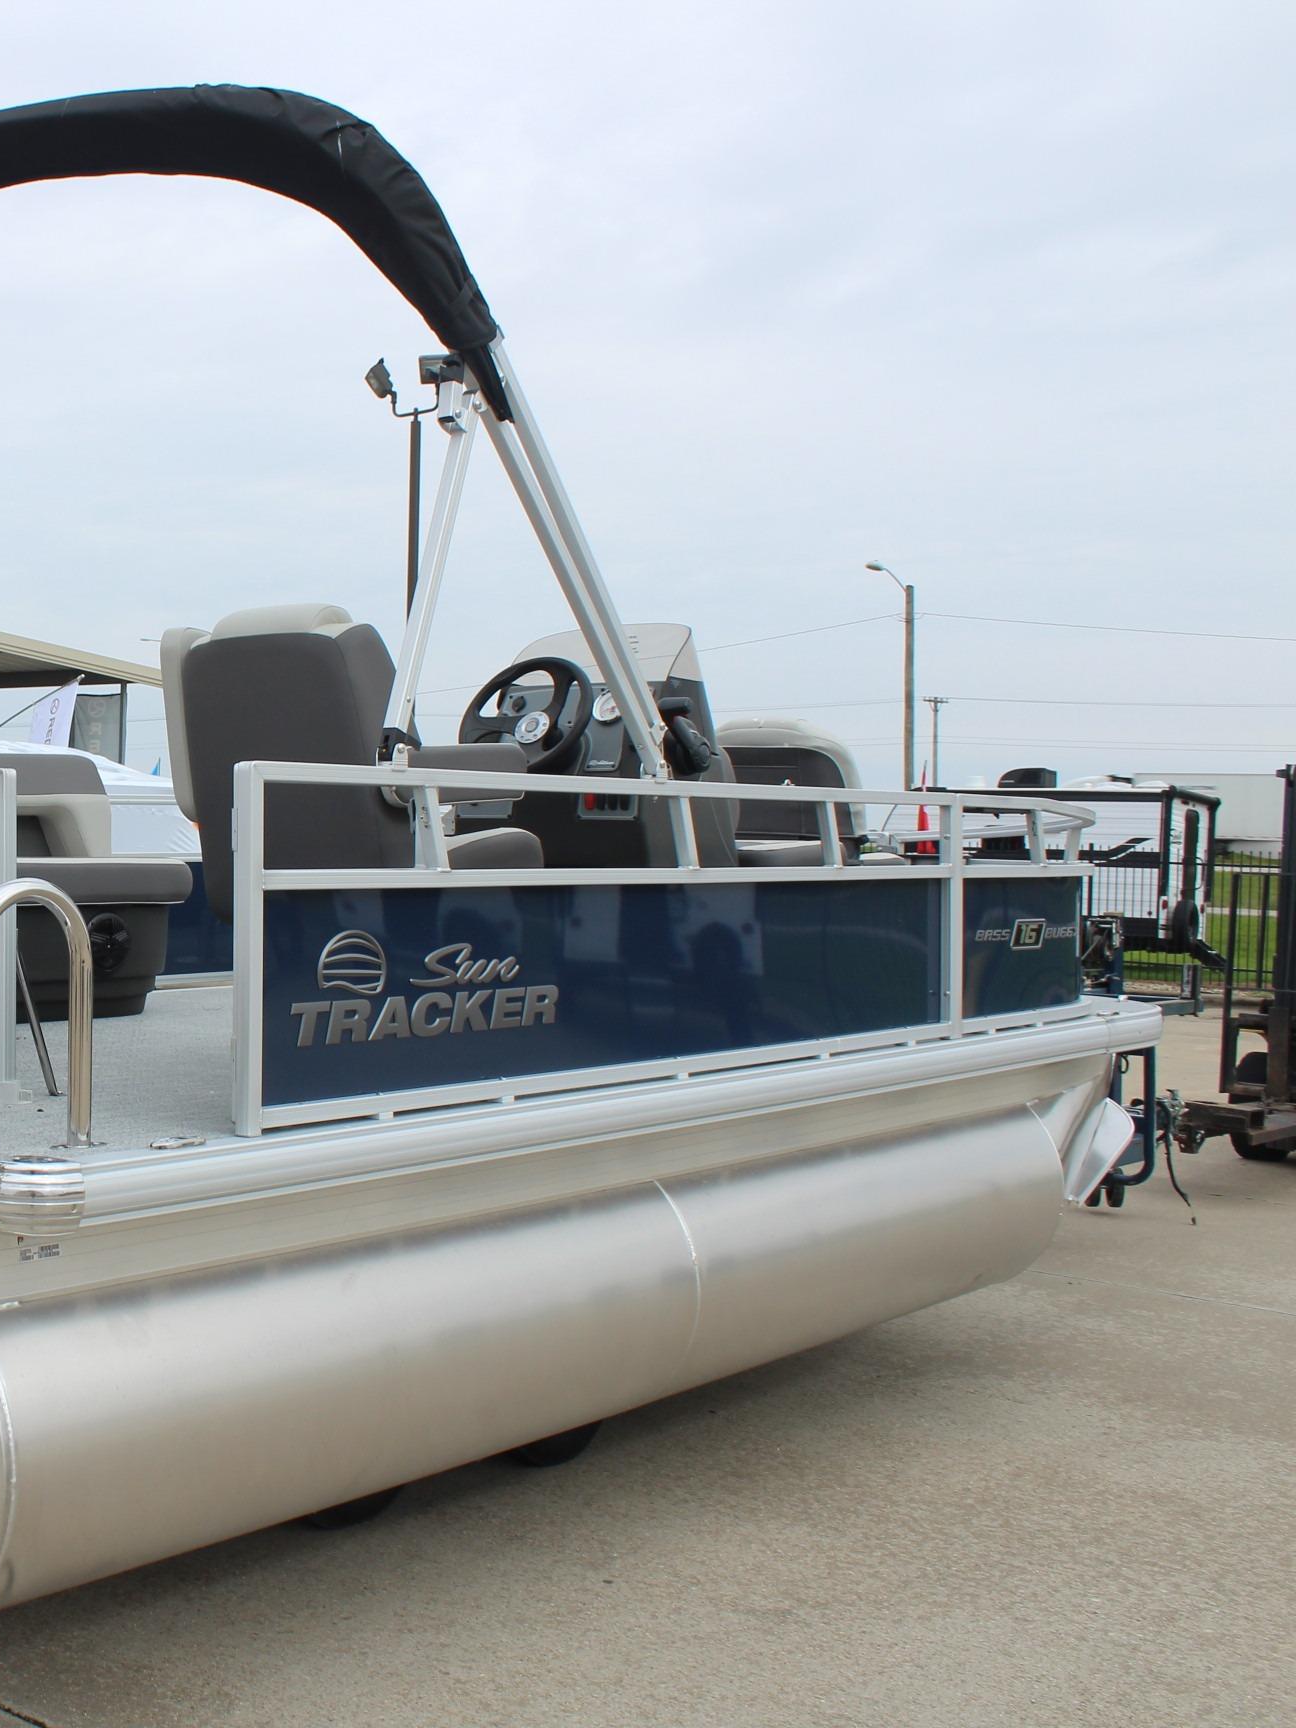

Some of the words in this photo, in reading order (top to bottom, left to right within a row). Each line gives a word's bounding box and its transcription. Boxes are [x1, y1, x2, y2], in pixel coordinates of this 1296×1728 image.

[975, 929, 1011, 941] BASS
[1018, 923, 1040, 944] 16
[409, 943, 521, 987] Sun
[289, 985, 560, 1048] TRACKER
